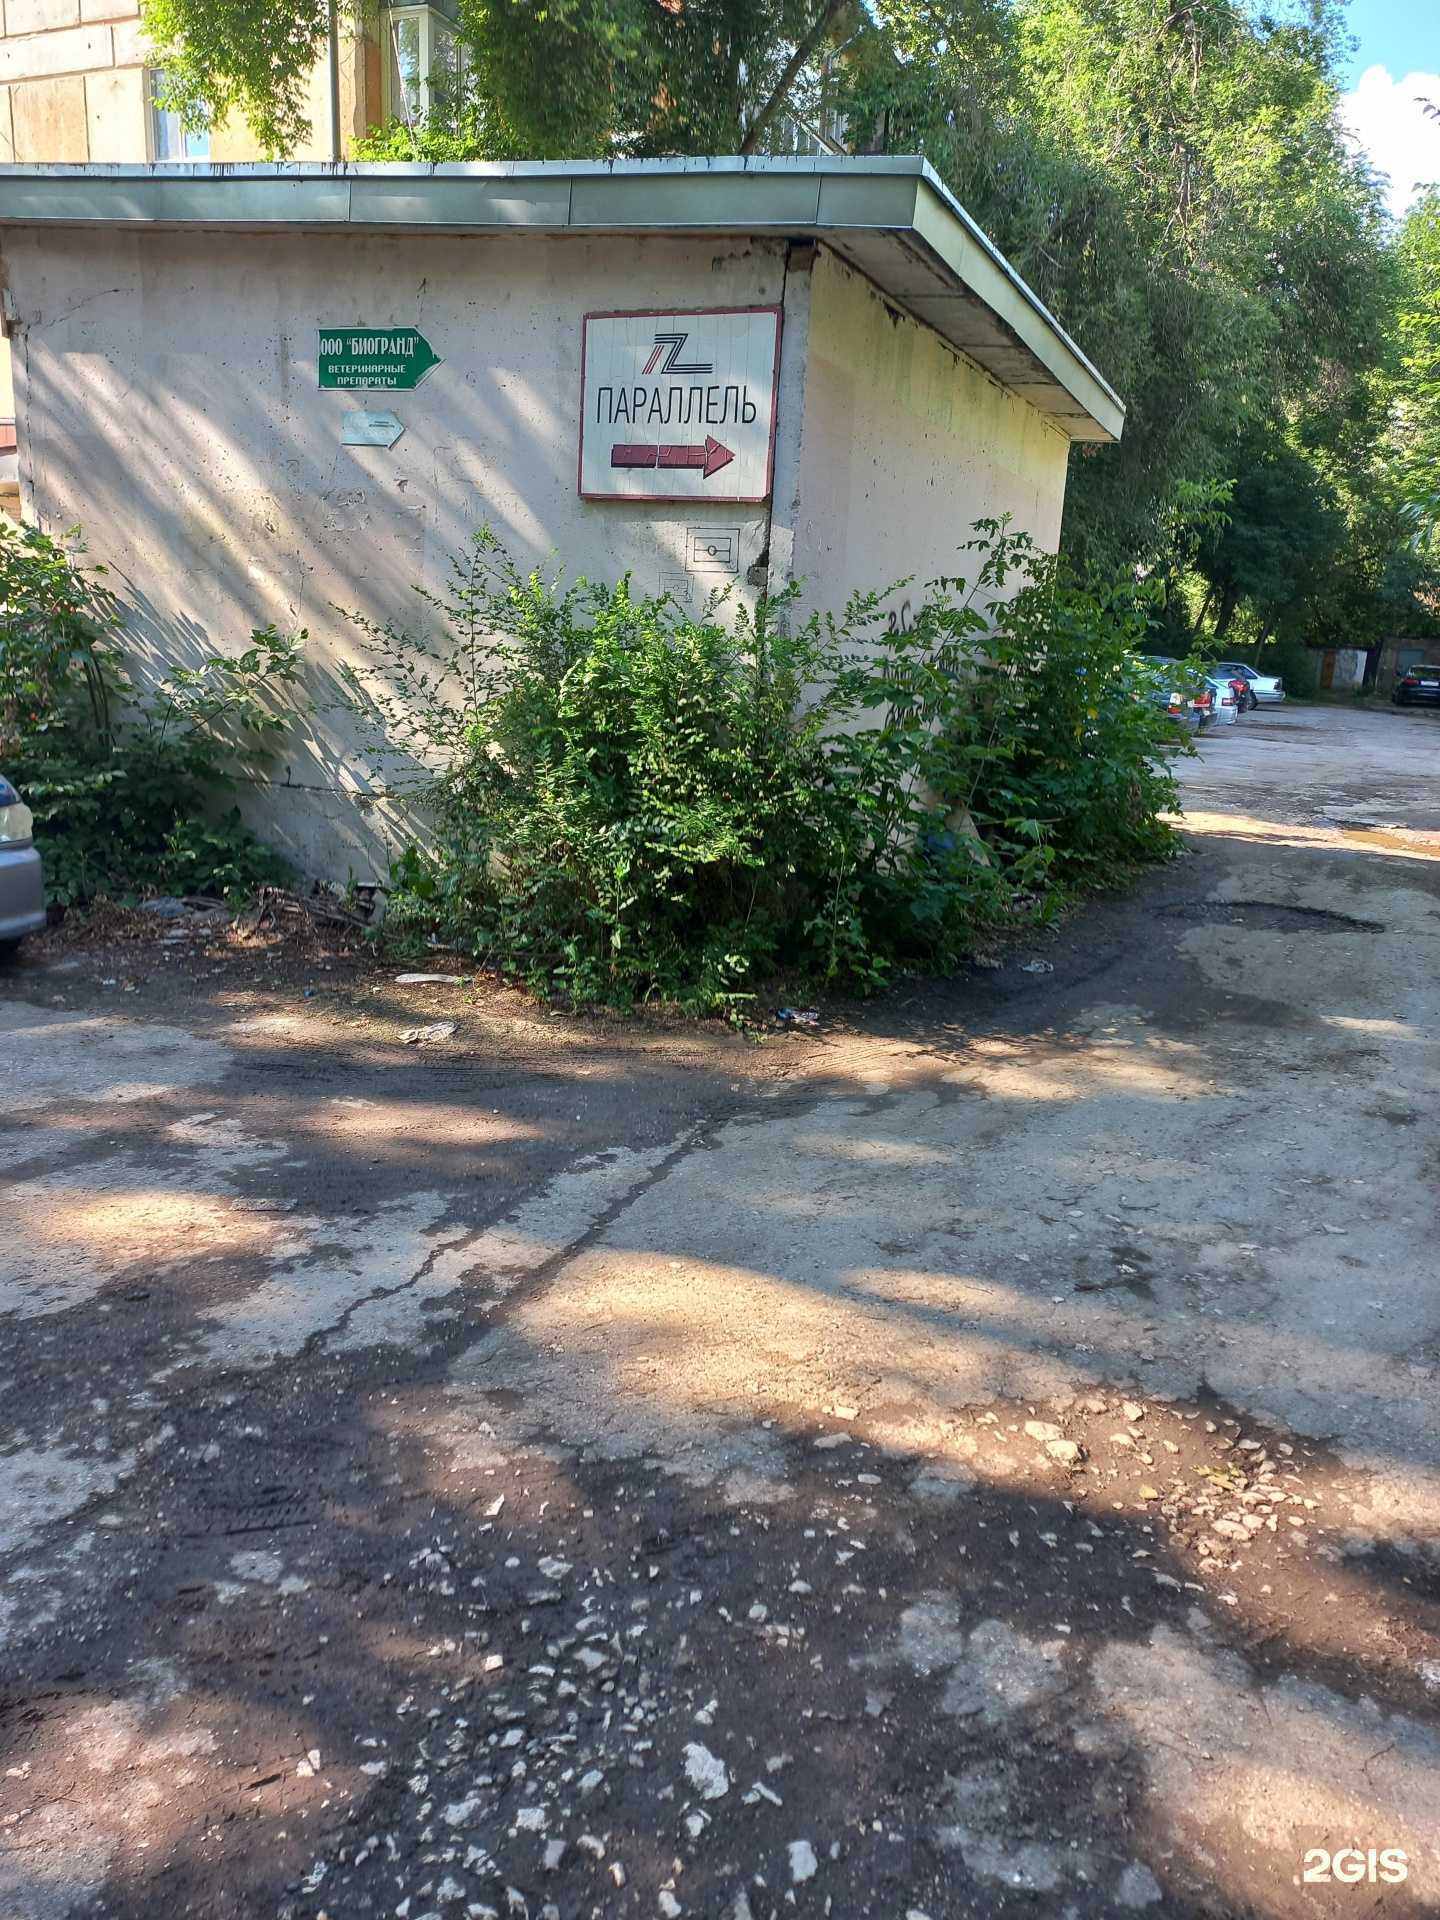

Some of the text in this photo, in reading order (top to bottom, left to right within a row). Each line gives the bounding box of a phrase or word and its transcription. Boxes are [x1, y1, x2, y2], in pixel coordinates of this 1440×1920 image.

[321, 339, 342, 355] ООО
[328, 364, 406, 373] ВЕТЕРИНАРНЫЕ
[337, 376, 396, 384] ПРЕПАРАТЫ
[597, 386, 756, 424] ПАРАЛЛЕЛЬ
